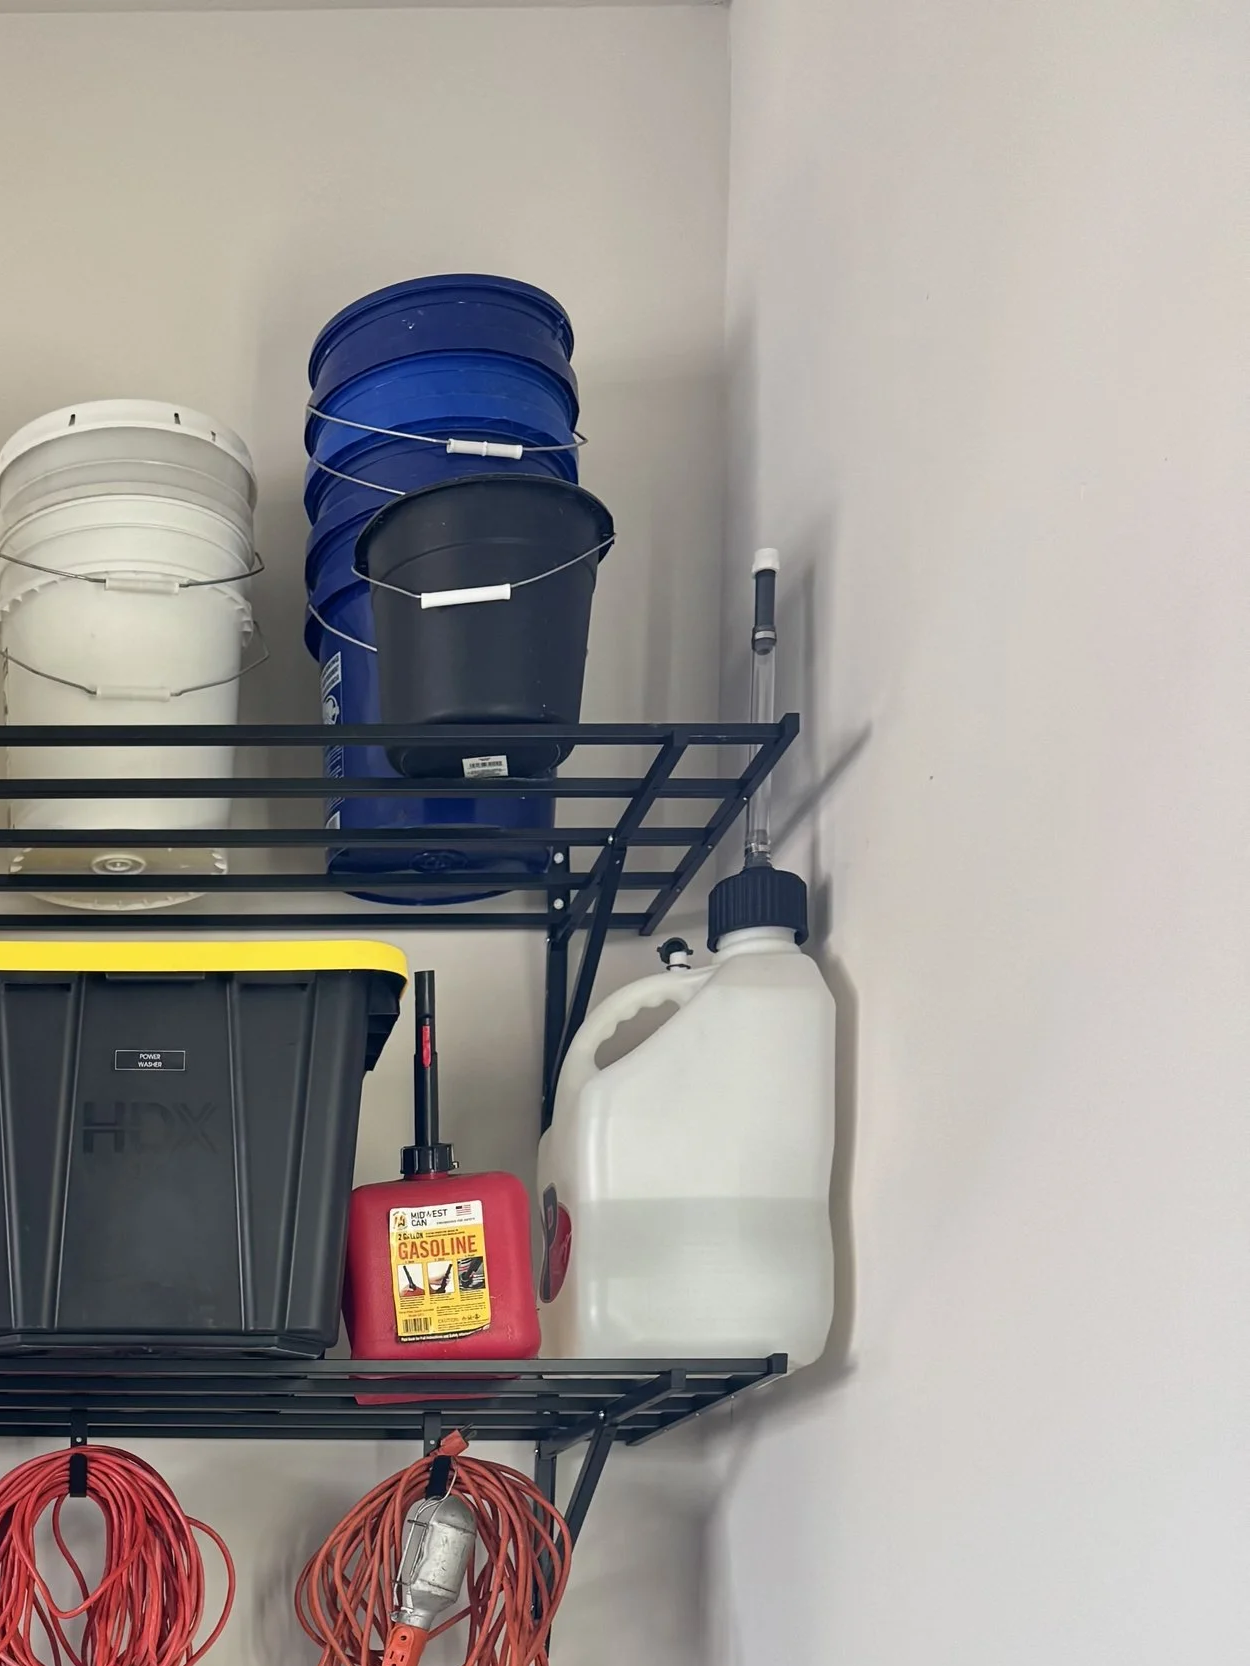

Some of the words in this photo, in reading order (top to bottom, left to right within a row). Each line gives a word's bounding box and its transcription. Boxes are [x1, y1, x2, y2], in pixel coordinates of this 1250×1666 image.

[82, 1101, 218, 1155] HDX
[411, 1219, 427, 1227] CAN
[398, 1234, 477, 1260] GASOLINE
